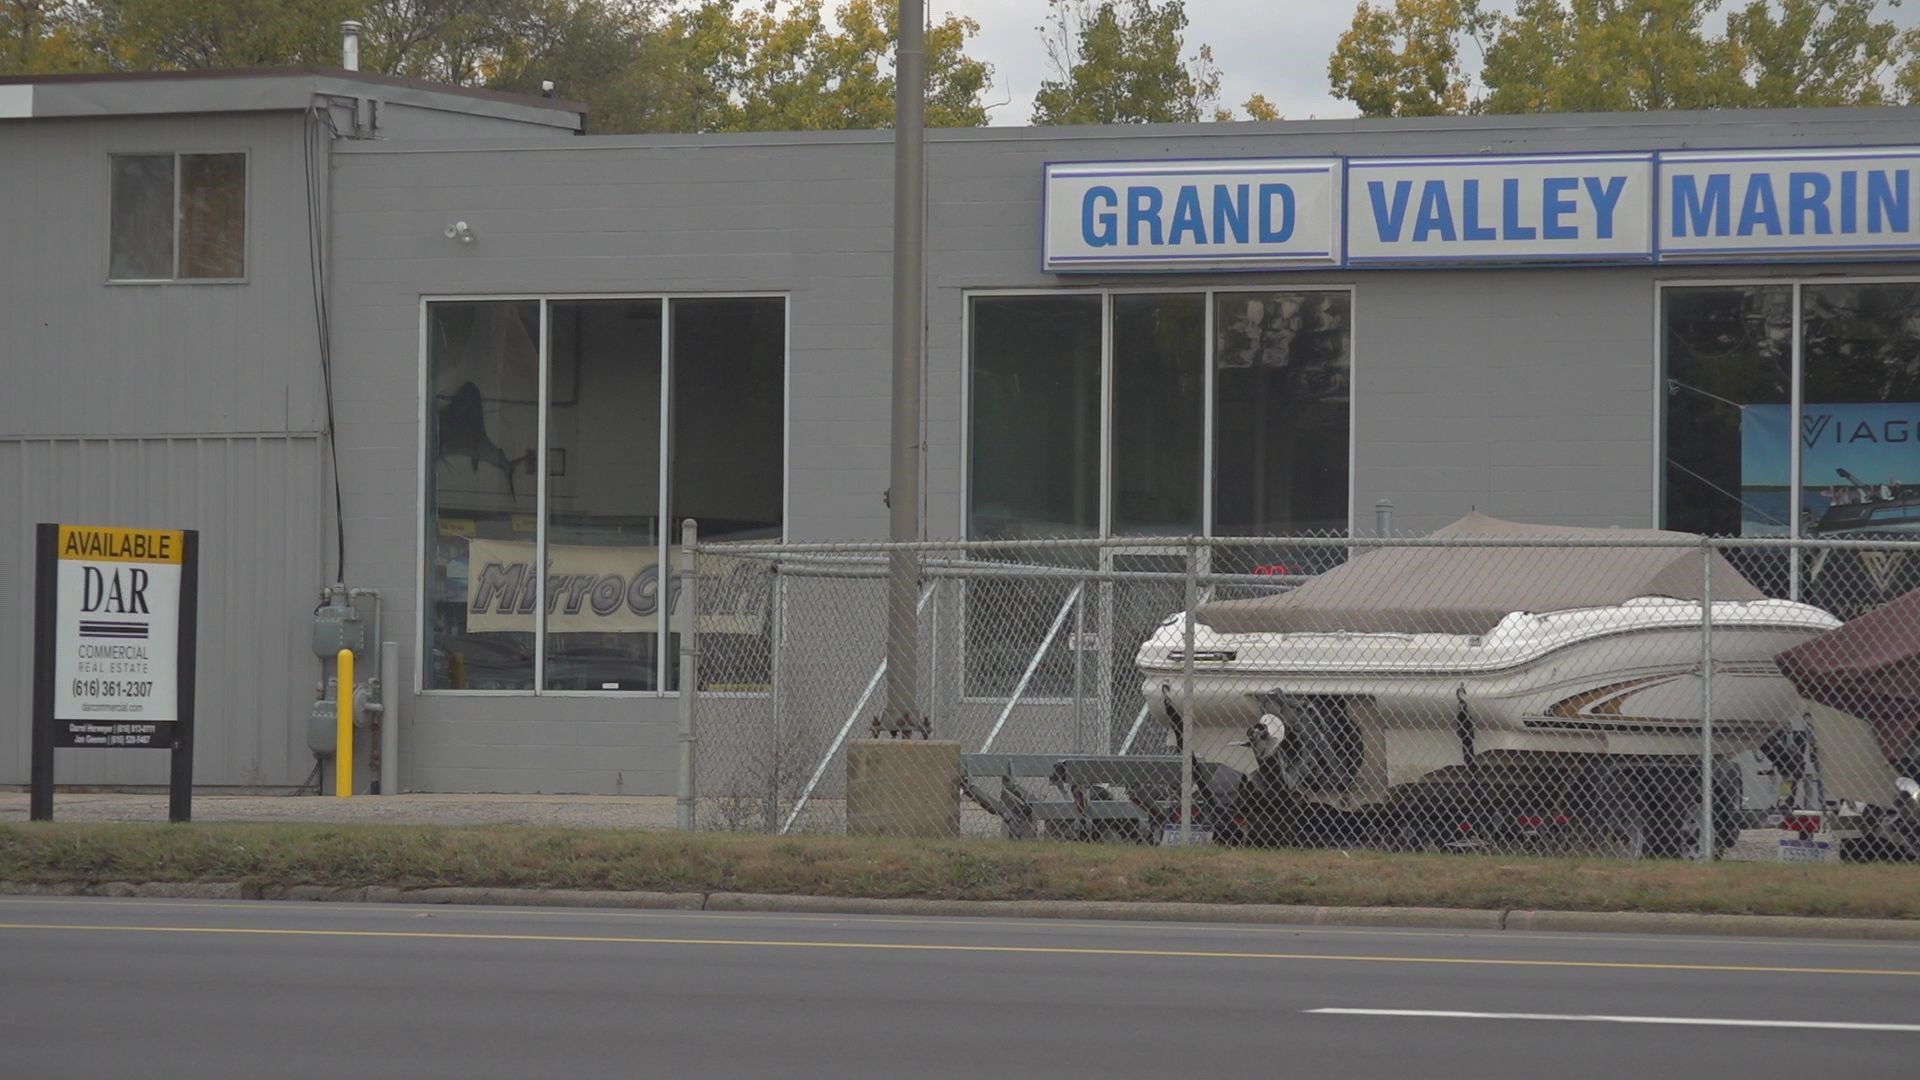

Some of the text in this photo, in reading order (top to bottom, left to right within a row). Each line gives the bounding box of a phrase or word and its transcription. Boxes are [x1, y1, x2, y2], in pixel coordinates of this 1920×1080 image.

[1081, 169, 1910, 247] GRAND VALLEY MARIN
[1801, 414, 1920, 449] VIAG
[65, 531, 170, 559] AVAILABLE
[80, 566, 150, 614] DAR
[78, 645, 149, 660] COMMERCIAL
[78, 662, 149, 674] REAL ESTATE
[72, 678, 153, 698] (616) 361-2307
